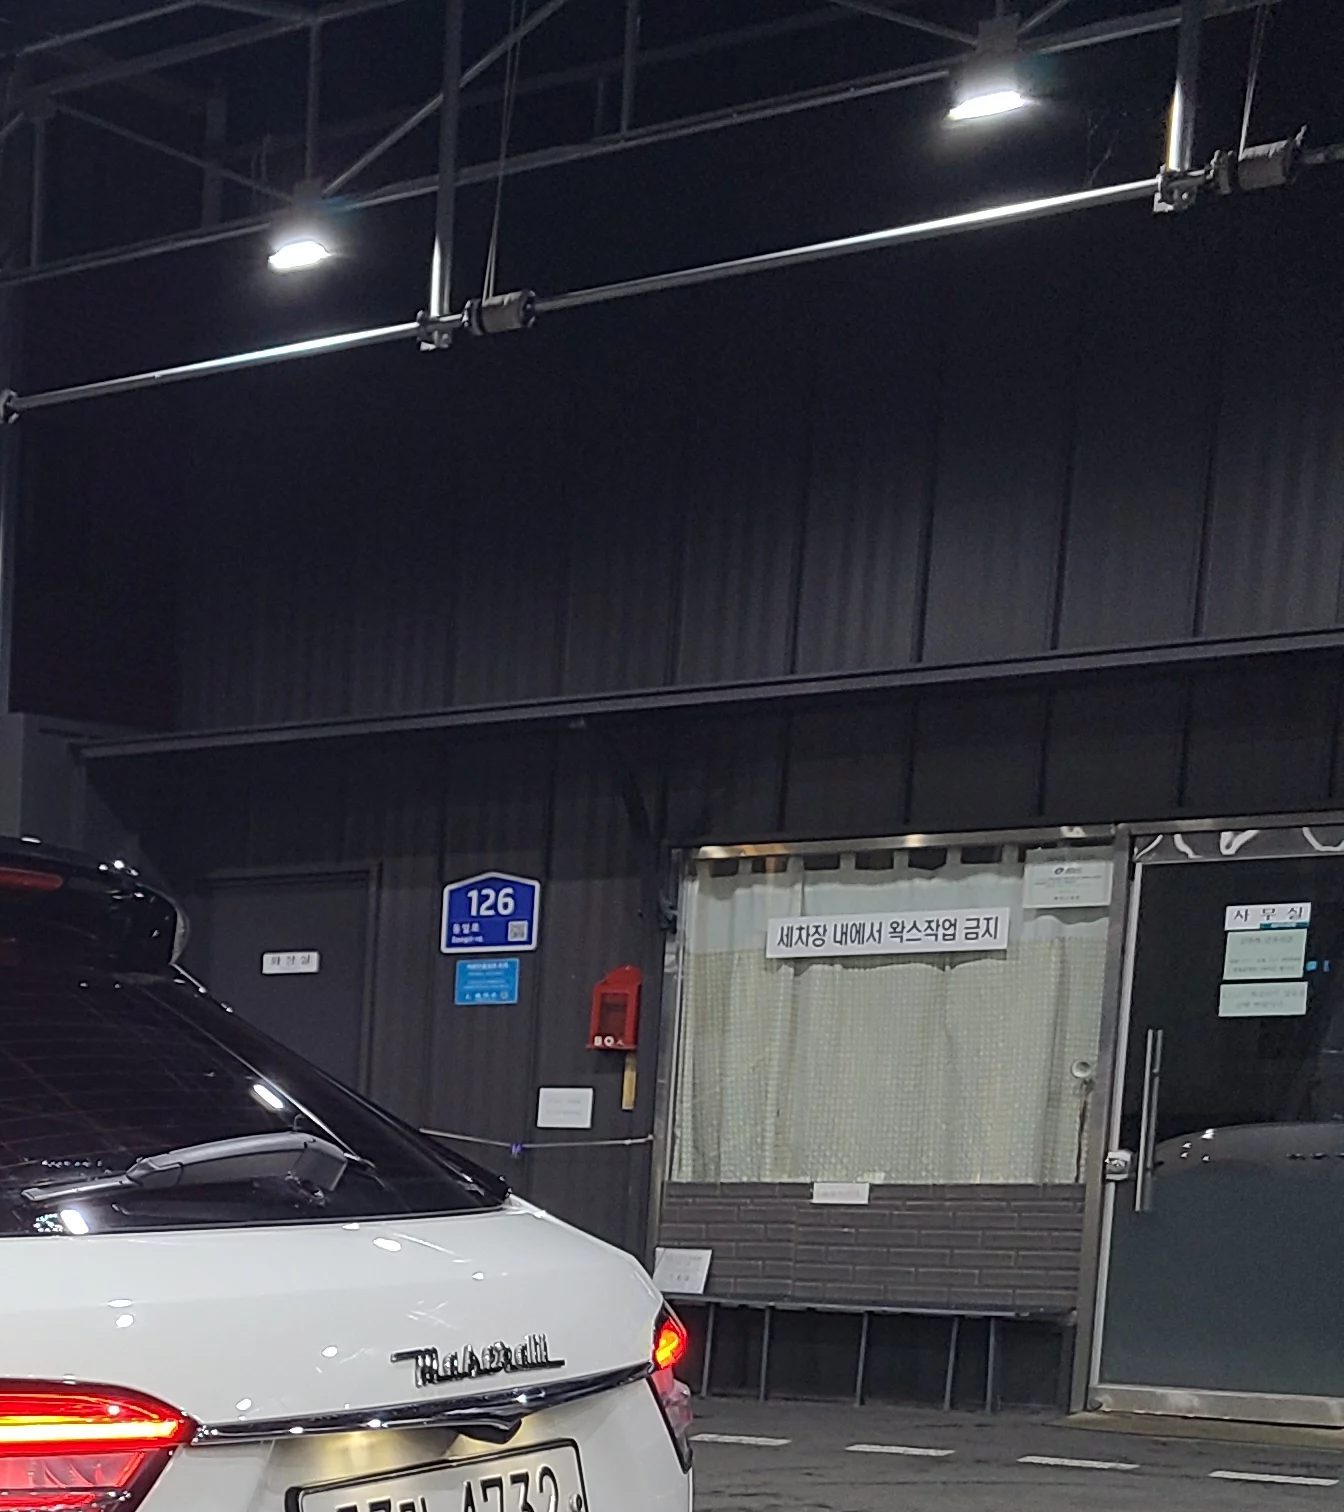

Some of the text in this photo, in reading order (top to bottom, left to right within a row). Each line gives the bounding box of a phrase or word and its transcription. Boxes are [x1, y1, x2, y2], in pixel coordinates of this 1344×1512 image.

[466, 887, 515, 917] 126
[777, 915, 999, 949] 세차장 내에서 왁스작업 금지
